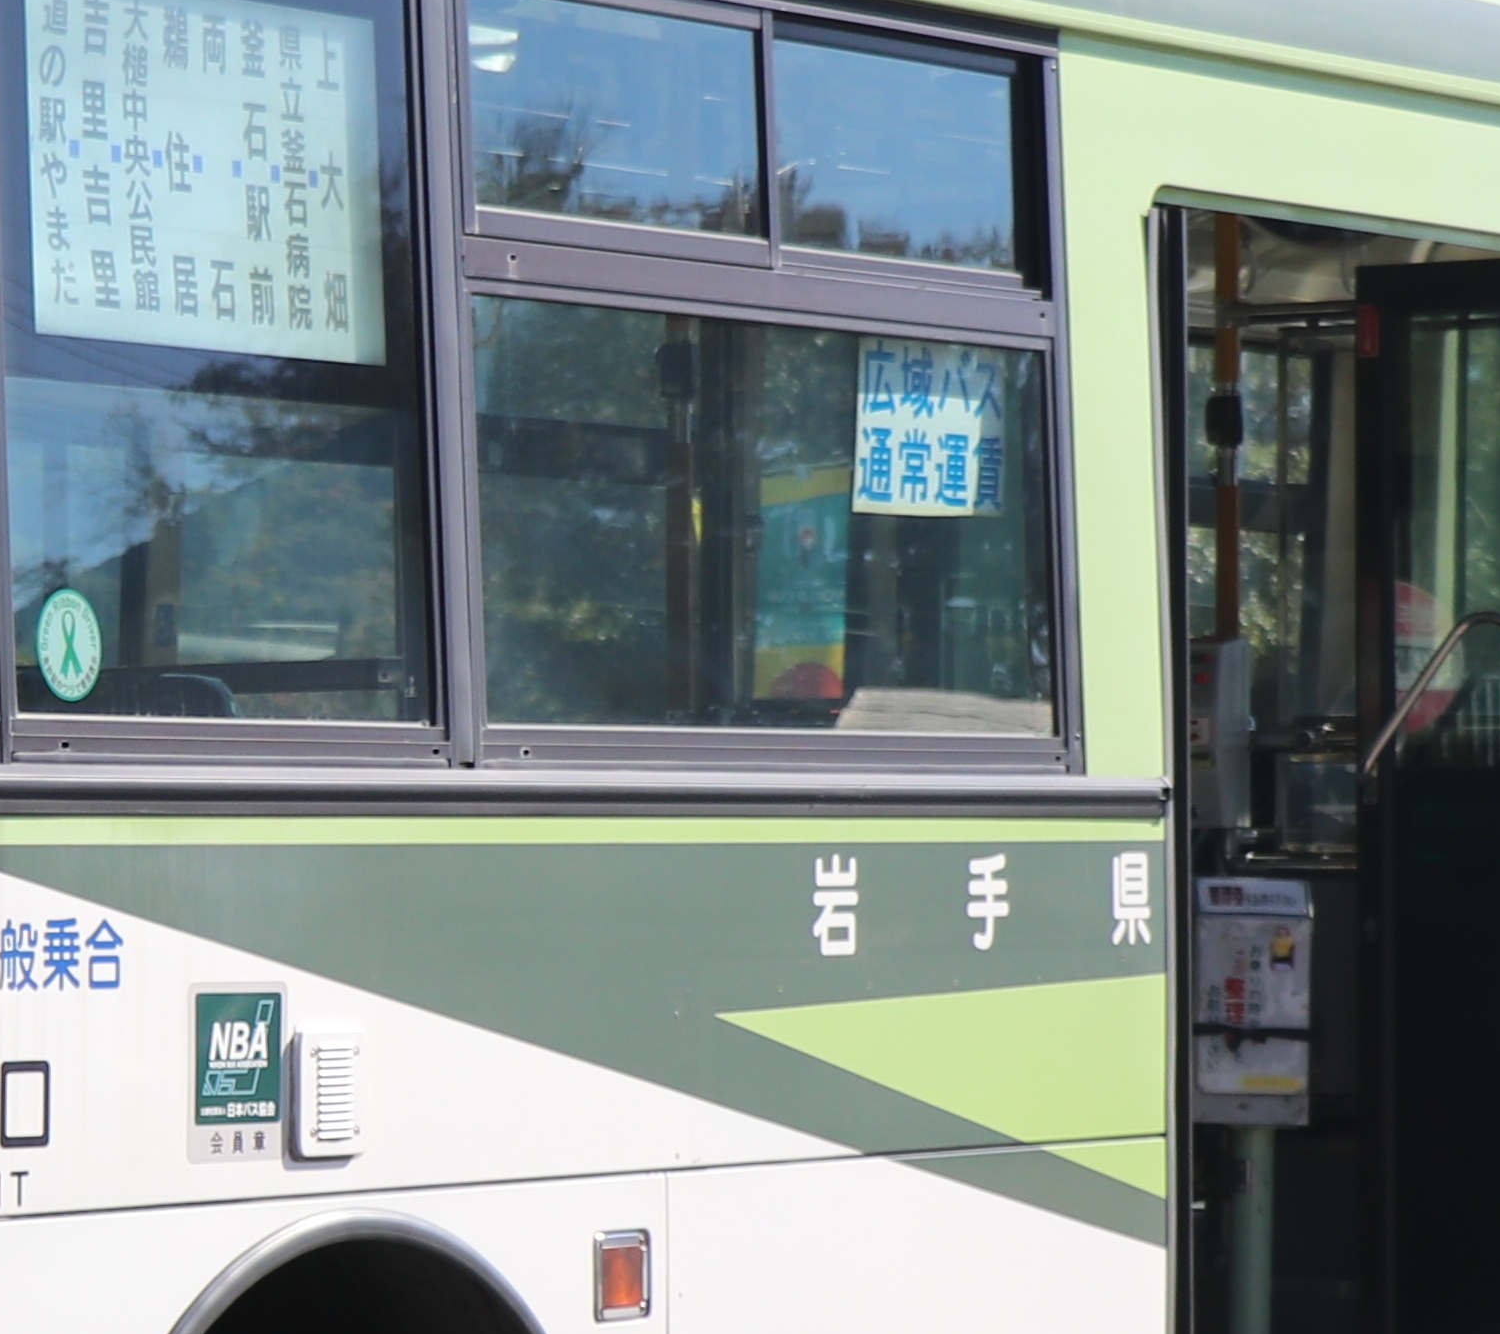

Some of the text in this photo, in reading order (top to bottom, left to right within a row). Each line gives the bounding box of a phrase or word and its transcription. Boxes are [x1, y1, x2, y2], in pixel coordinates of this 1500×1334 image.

[122, 0, 160, 313] 大槌中央公民館
[201, 13, 237, 323] 両石
[240, 20, 275, 326] 釜石駅前
[279, 25, 313, 331] 県立釜石病院
[316, 30, 349, 334] 上大畑
[858, 426, 1003, 511] 通常運賃
[862, 339, 1003, 420] 広域バス
[208, 1020, 269, 1062] NBA
[209, 1130, 266, 1155] 会員章
